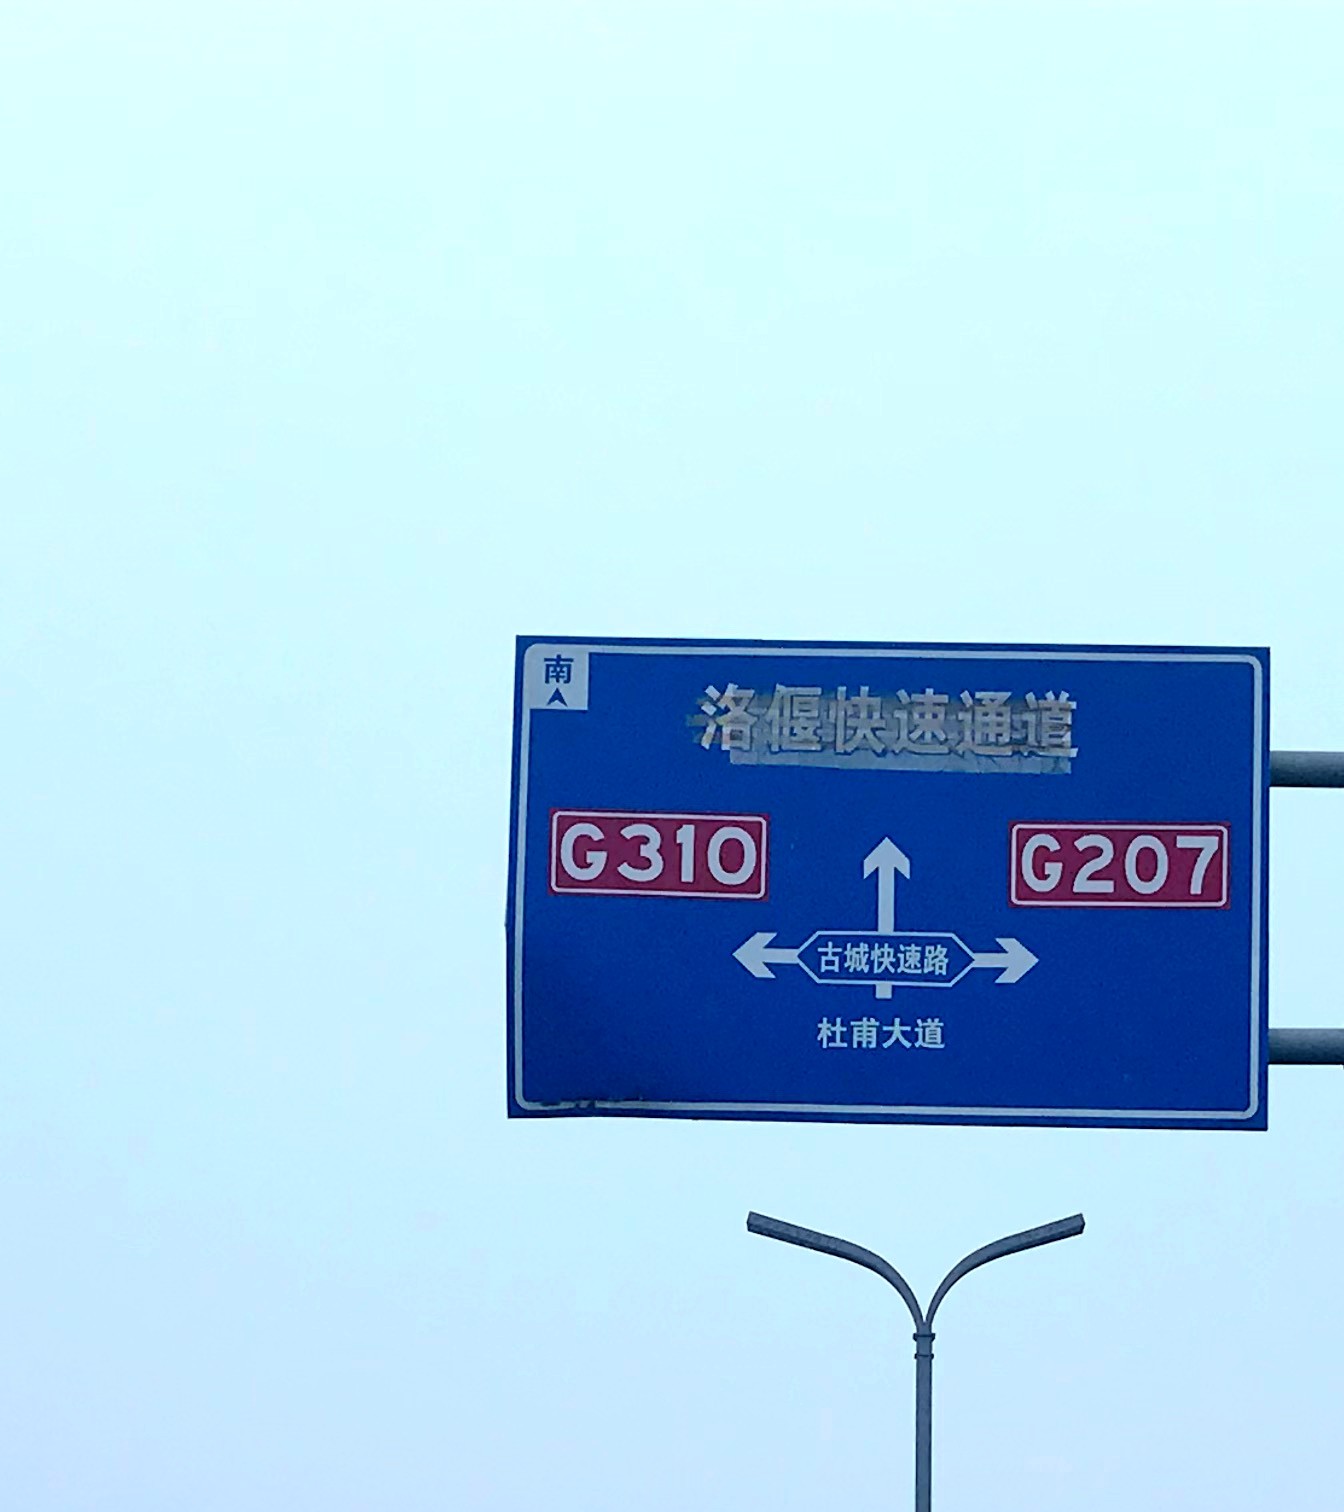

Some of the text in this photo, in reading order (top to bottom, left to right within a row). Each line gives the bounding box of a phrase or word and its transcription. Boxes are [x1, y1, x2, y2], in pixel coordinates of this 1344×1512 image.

[543, 653, 574, 684] 南
[700, 683, 1079, 758] 洛偃快速通道
[559, 822, 758, 887] G310
[1020, 833, 1220, 896] G207
[817, 941, 950, 976] 古城快速路
[817, 1016, 946, 1049] 杜甫大道
